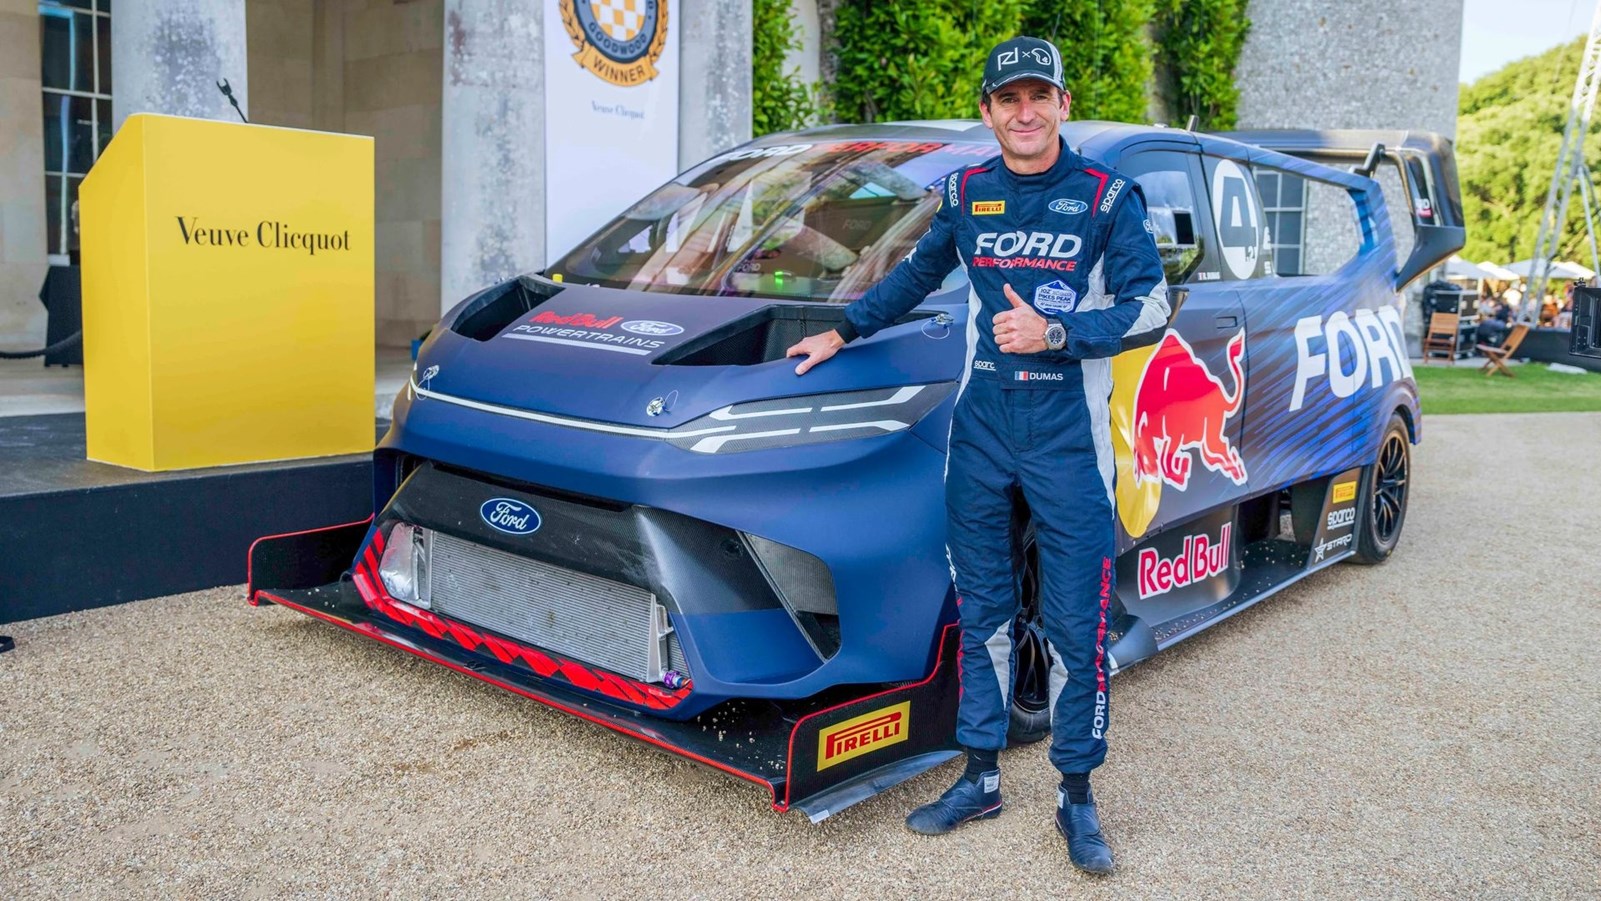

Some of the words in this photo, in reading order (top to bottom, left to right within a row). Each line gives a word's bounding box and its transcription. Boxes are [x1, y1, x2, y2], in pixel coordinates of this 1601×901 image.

[588, 21, 647, 55] GOODWOOD
[593, 55, 646, 82] WINNER
[974, 203, 1002, 213] PIRELLI
[1055, 200, 1081, 212] Ford
[1100, 178, 1125, 213] sparco
[174, 215, 249, 247] Veuve
[256, 220, 352, 256] Clicquot
[974, 231, 1082, 259] FORD
[972, 256, 1077, 272] PERFORMANCE
[513, 324, 666, 349] POWERTRAINS
[1029, 372, 1064, 381] DUMAS
[489, 501, 531, 531] Ford
[1327, 507, 1356, 530] sparco
[1139, 536, 1192, 599] Red
[1192, 522, 1231, 582] Bull
[1091, 690, 1107, 740] FORD
[825, 711, 902, 760] PIRELLI
